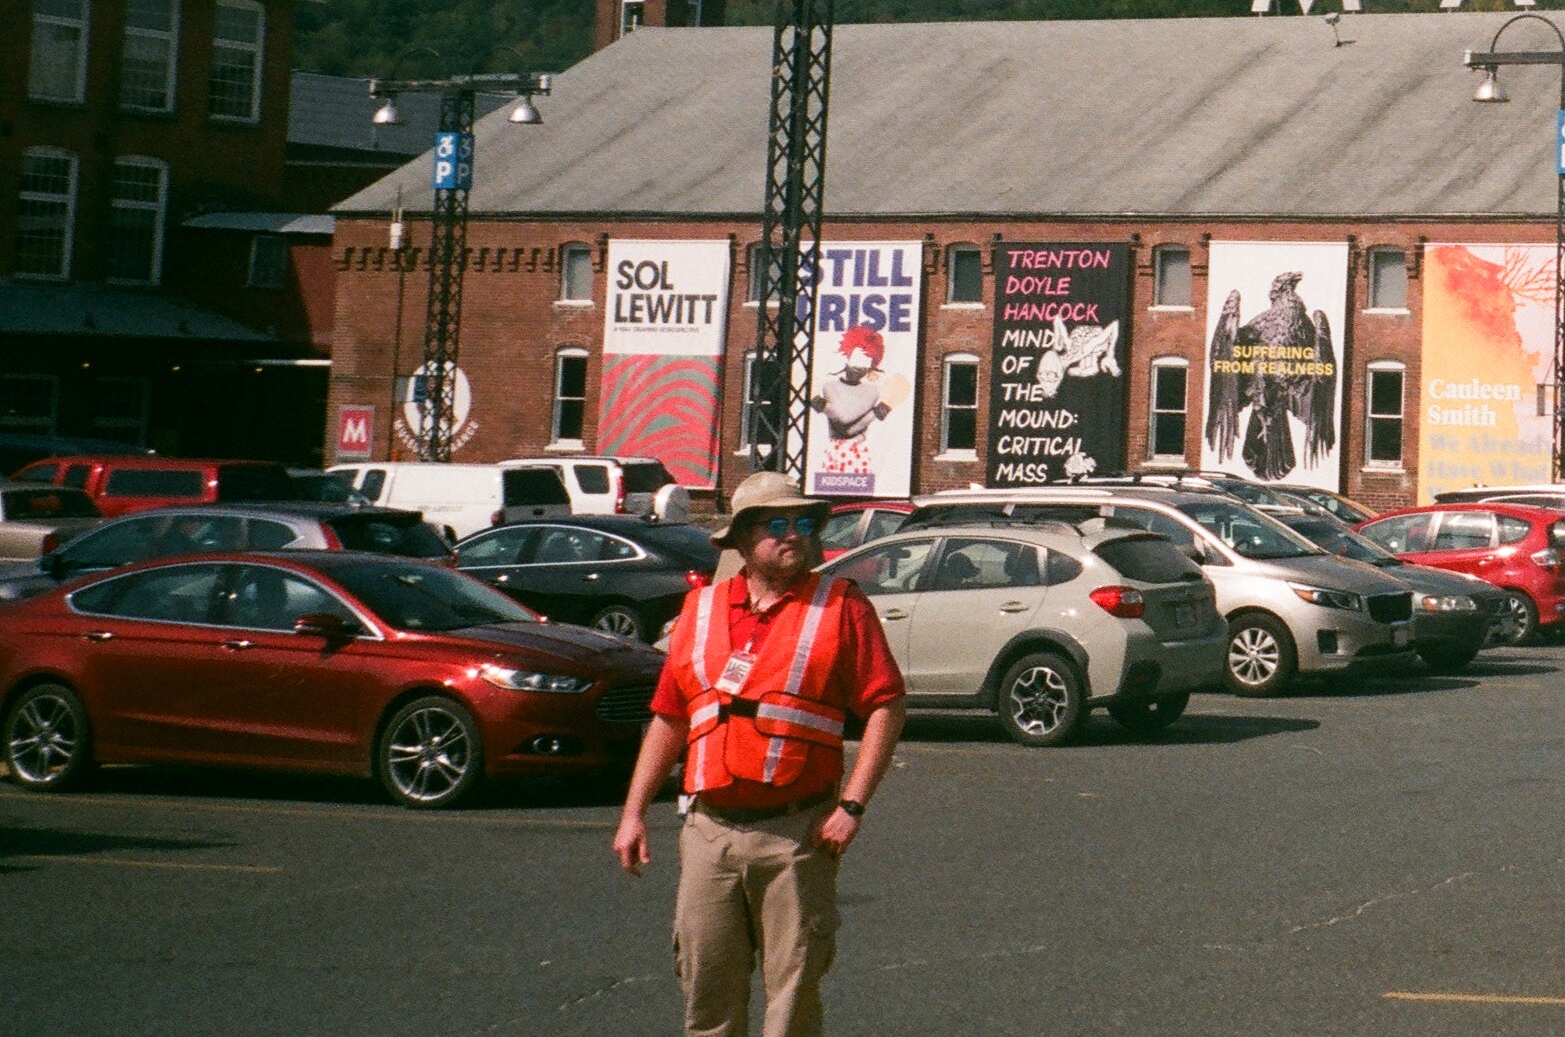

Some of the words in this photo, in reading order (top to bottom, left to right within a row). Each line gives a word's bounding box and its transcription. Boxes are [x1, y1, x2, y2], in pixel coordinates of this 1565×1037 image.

[435, 161, 451, 183] P
[1007, 249, 1111, 269] TRENTON
[616, 259, 674, 290] SOL
[1005, 275, 1071, 295] DOYLE
[614, 293, 718, 324] LEWITT
[818, 293, 913, 333] RISE
[1003, 302, 1099, 322] HANCOCK
[1001, 329, 1056, 348] MIND
[1232, 345, 1315, 360] SUFFERING
[1001, 355, 1034, 374] OF
[1213, 360, 1255, 374] FROM
[1260, 362, 1334, 376] REALNESS
[1001, 382, 1044, 402] THE
[1428, 378, 1521, 400] Cauleen
[998, 409, 1078, 429] MOUND:
[1427, 404, 1497, 426] Smith
[342, 418, 367, 443] M
[997, 435, 1086, 456] CRITICAL
[995, 463, 1048, 482] MASS
